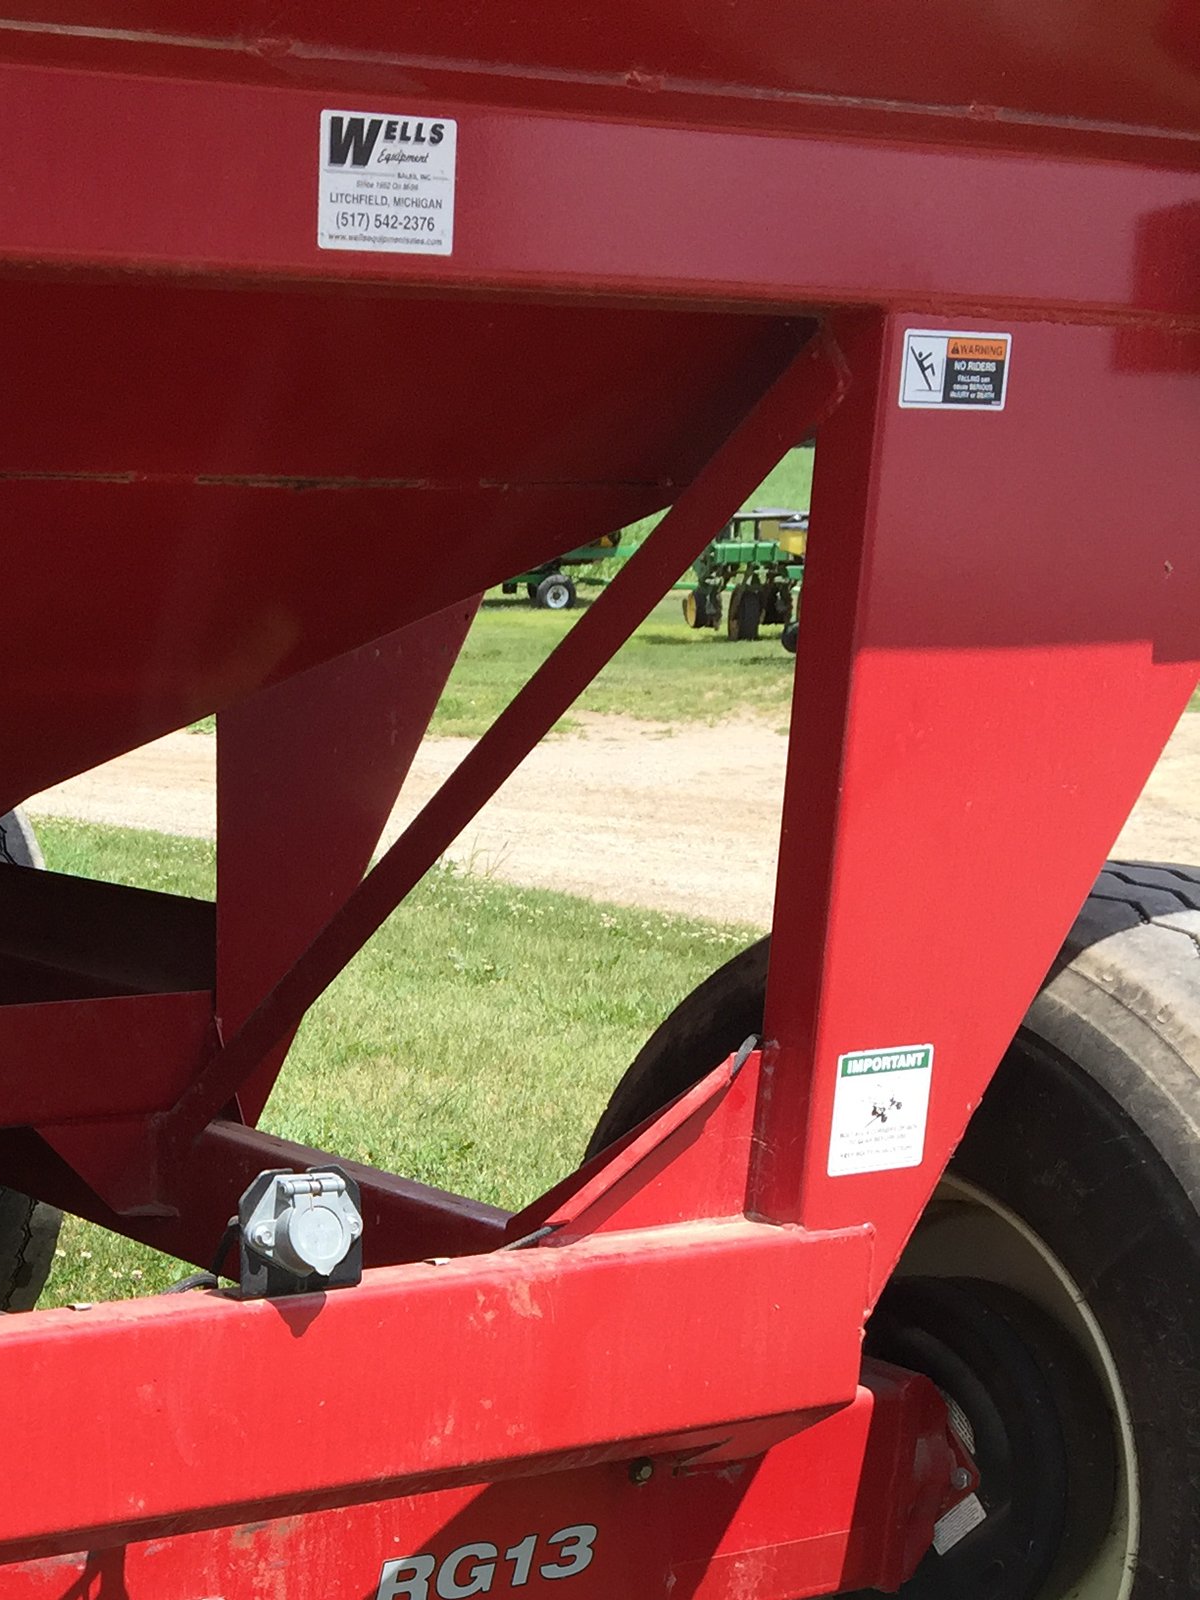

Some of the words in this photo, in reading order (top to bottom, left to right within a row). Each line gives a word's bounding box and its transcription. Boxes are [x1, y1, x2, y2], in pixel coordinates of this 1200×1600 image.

[376, 148, 430, 165] Equipment
[329, 192, 390, 208] LITCHFIELD,
[393, 196, 443, 209] MICHIGAN
[336, 211, 370, 231] (517)
[374, 214, 435, 232] 542-2376
[960, 344, 1003, 356] WARNING
[954, 360, 966, 371] NO
[967, 361, 996, 373] RIDERS
[847, 1051, 925, 1074] IMPORTANT
